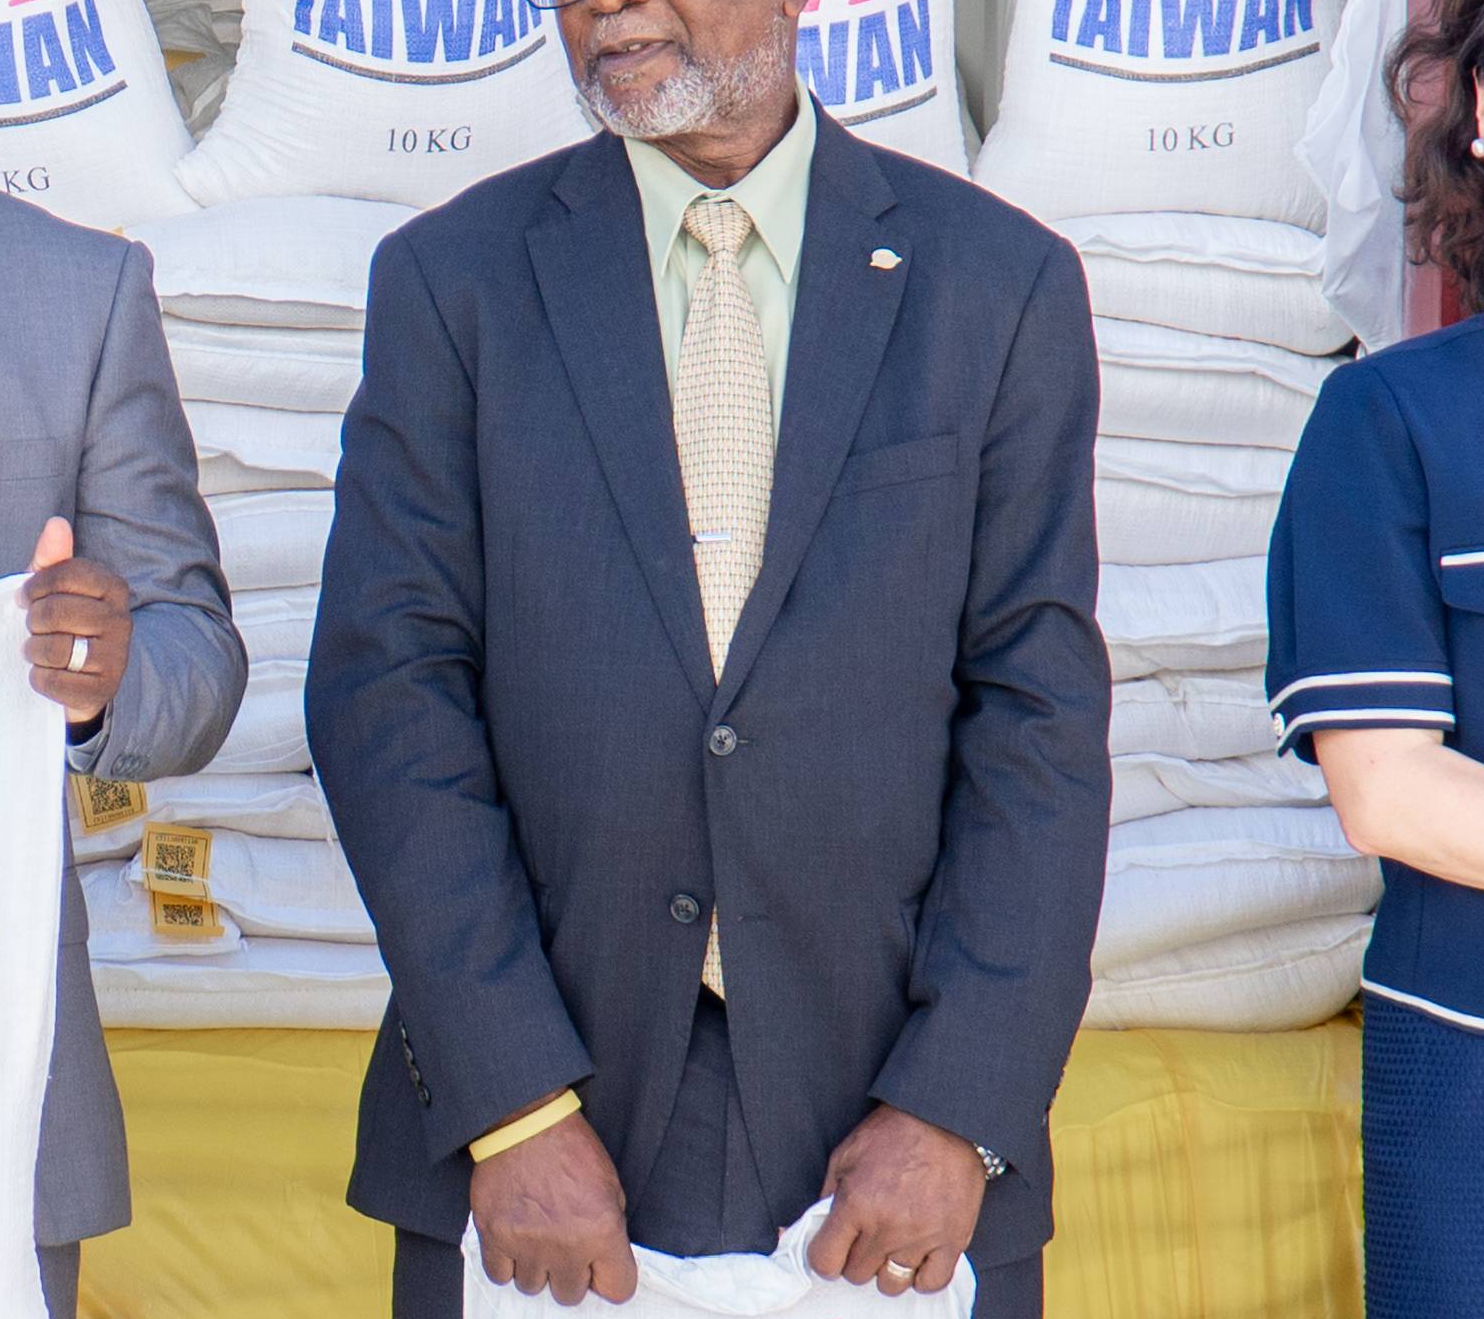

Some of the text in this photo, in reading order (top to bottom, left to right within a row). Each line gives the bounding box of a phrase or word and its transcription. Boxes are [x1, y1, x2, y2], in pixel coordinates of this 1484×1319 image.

[388, 127, 471, 154] 10 KG
[1148, 121, 1234, 152] 10 KG
[2, 166, 50, 194] KG
